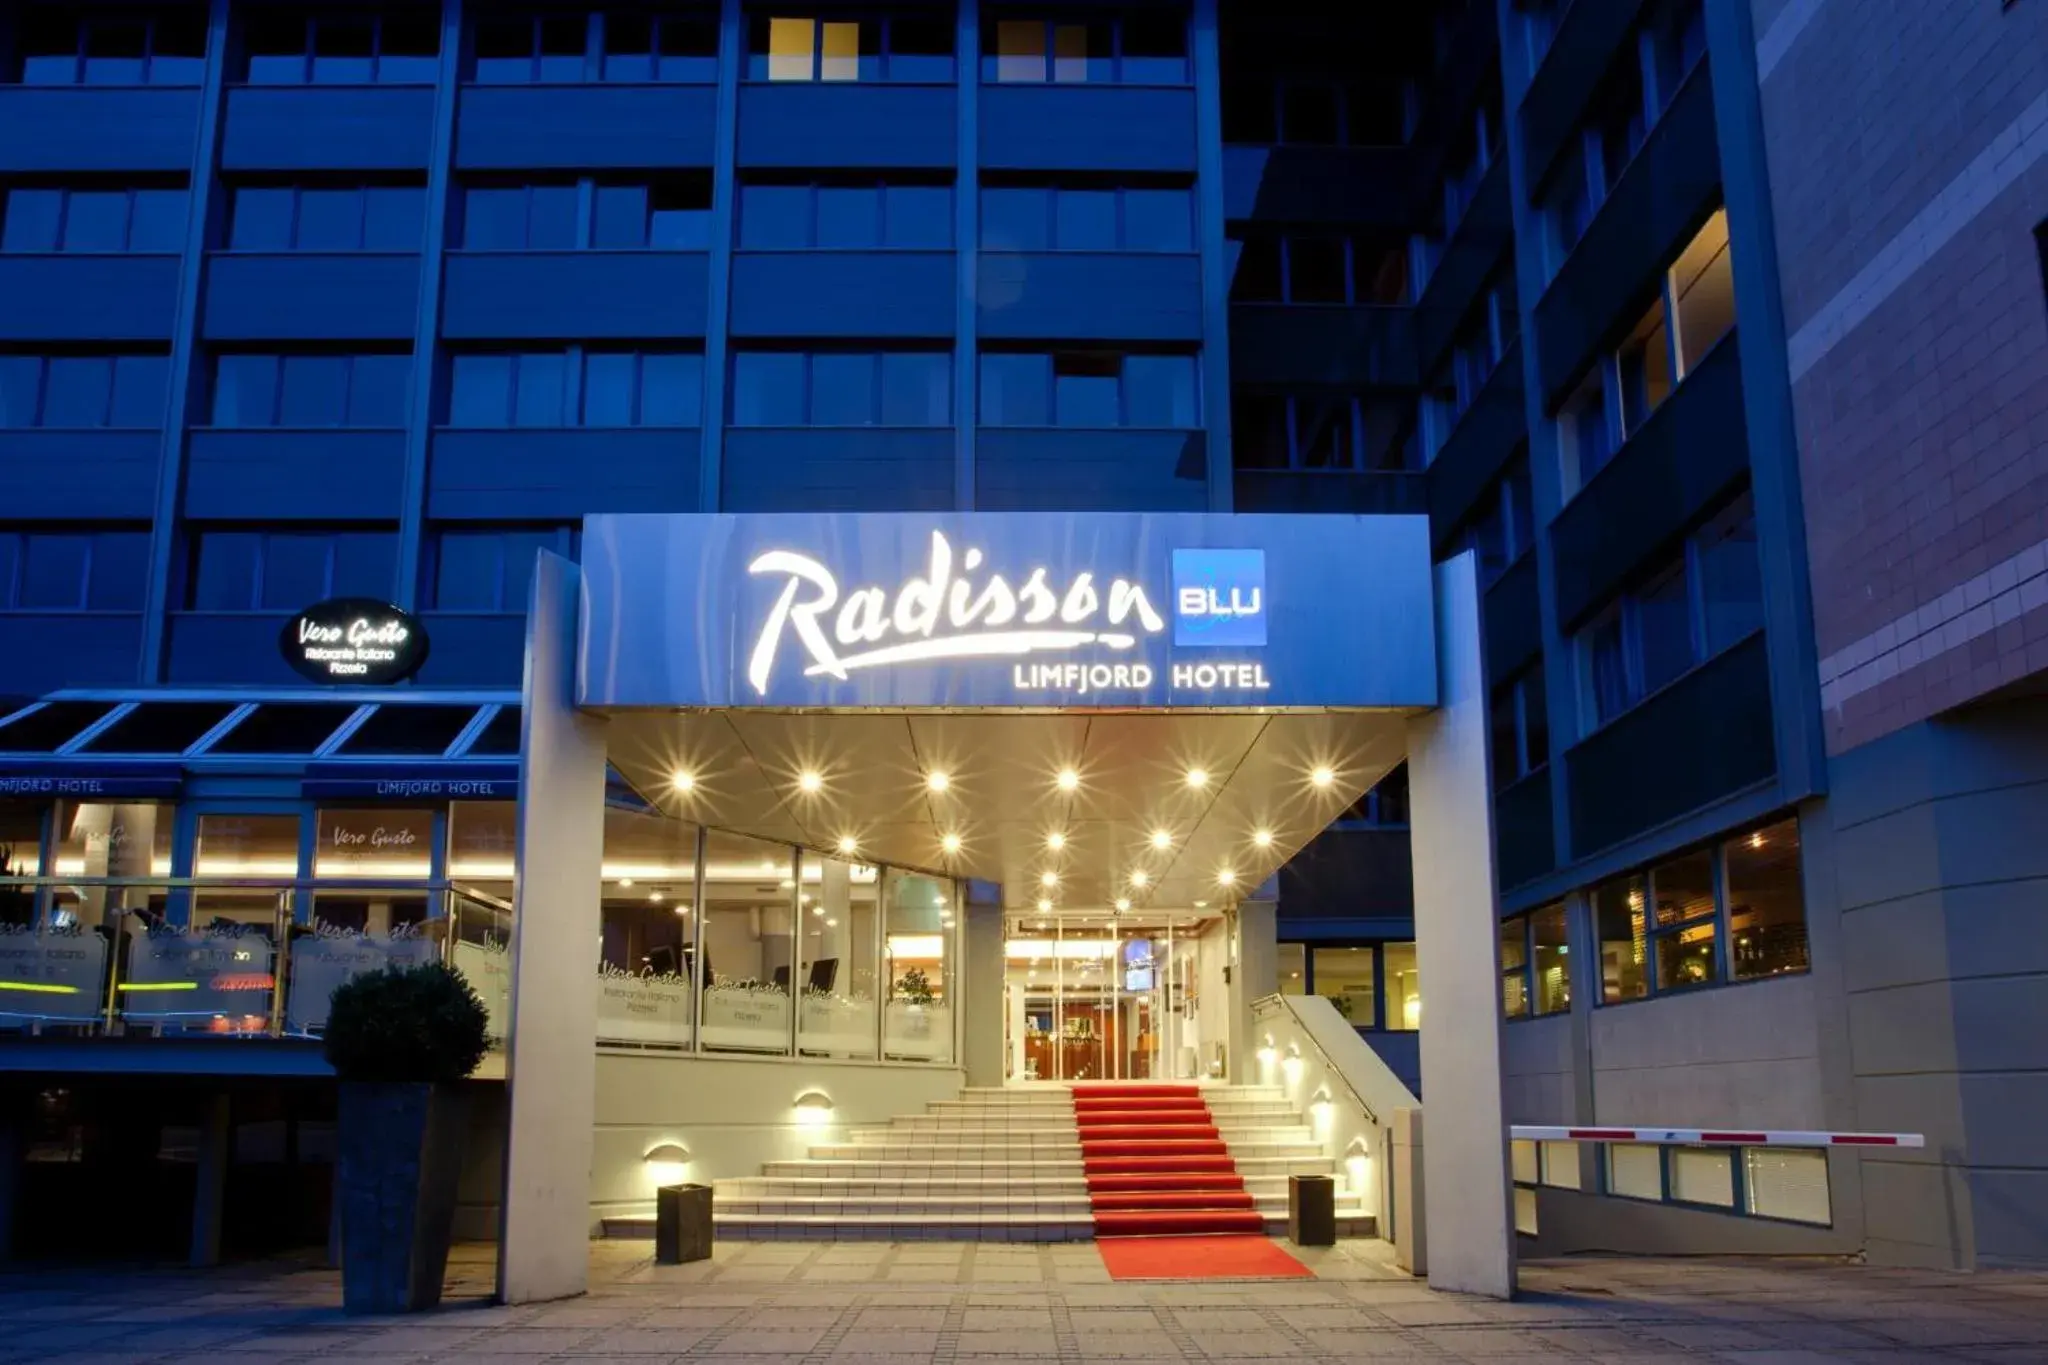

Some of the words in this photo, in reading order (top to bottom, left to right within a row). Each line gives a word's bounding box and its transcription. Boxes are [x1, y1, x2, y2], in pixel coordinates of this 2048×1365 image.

[748, 529, 1165, 697] Radisson
[1179, 587, 1261, 615] BLU
[299, 617, 342, 644] Vero
[347, 617, 408, 647] Gusto
[1013, 663, 1153, 694] LIMFJORD
[1172, 663, 1271, 688] HOTEL
[58, 780, 104, 793] HOTEL
[377, 780, 442, 796] LIMFJORD
[448, 781, 495, 795] HOTEL
[333, 825, 366, 847] Vero
[371, 824, 416, 848] Gusto
